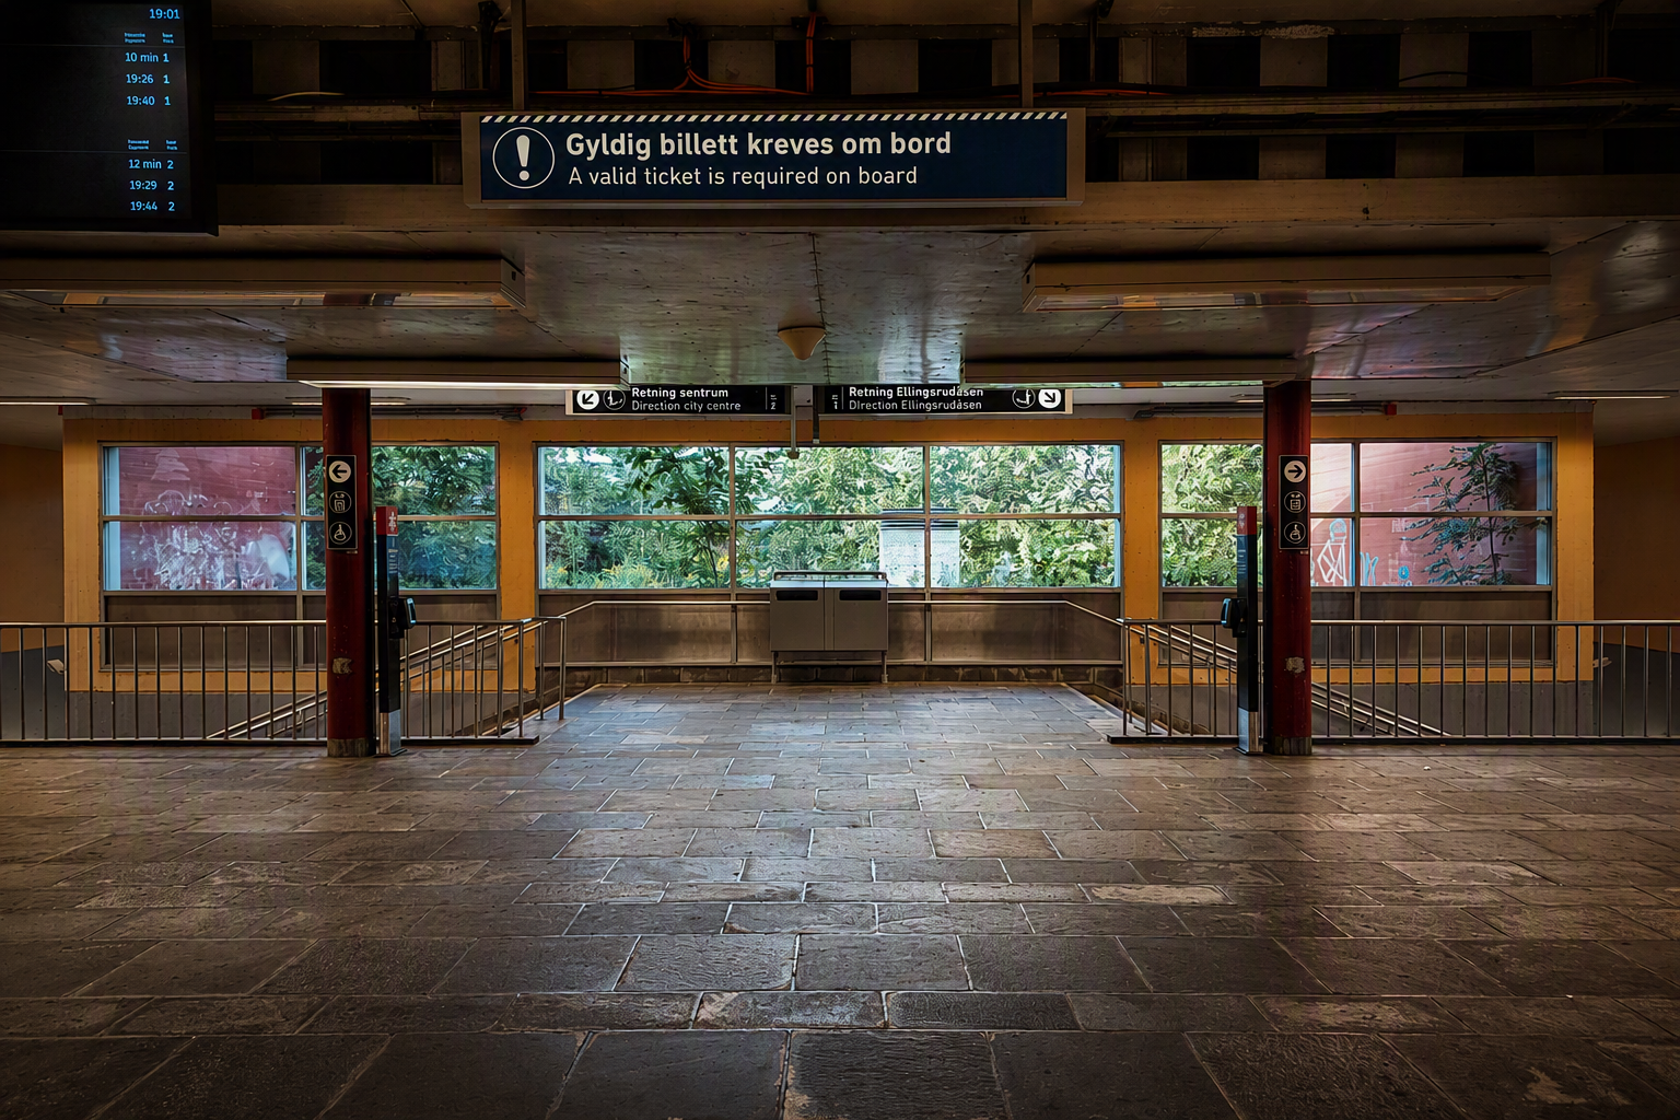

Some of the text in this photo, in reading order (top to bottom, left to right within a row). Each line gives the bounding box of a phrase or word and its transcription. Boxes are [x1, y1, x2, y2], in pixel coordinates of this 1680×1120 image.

[149, 8, 181, 20] 19:01
[125, 51, 170, 62] 10 min 1
[126, 73, 170, 84] 19:26 1
[126, 95, 171, 106] 19:40 1
[567, 131, 951, 160] Gyldig billett kreves om bord
[128, 158, 174, 169] 12 min 2
[568, 166, 918, 190] A valid ticket is required on board
[129, 180, 175, 191] 19:29 2
[130, 200, 175, 211] 19:44 2
[631, 387, 729, 399] Retning sentrum
[848, 386, 894, 399] Retning
[631, 399, 742, 413] Direction city centre
[770, 401, 777, 410] 2
[848, 398, 982, 412] Direction Ellingsrudåsen
